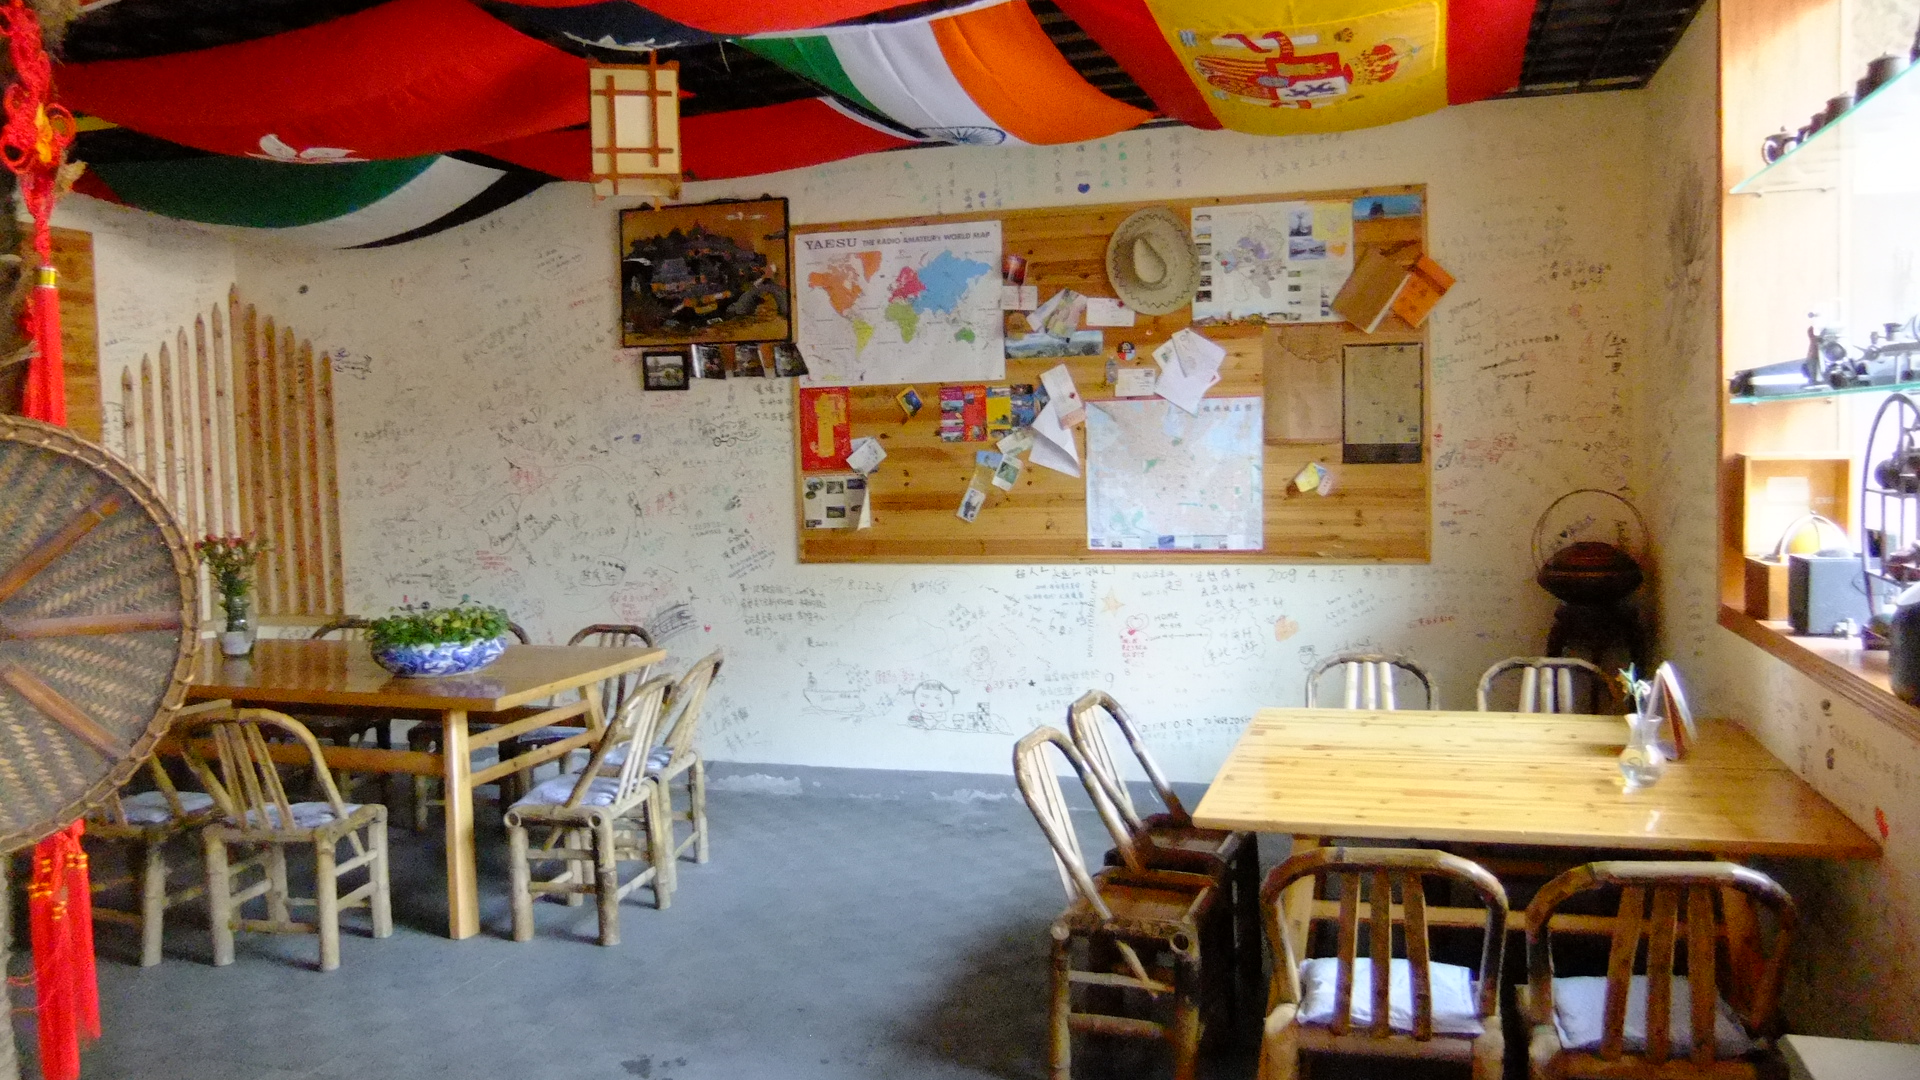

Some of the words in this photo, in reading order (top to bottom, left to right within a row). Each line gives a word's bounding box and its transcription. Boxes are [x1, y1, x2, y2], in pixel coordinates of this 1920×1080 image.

[804, 237, 857, 250] YAESU
[862, 239, 875, 247] THE
[877, 236, 901, 246] RADIO
[943, 231, 971, 241] WORLD
[972, 230, 991, 240] MAP
[1266, 568, 1297, 584] 2009
